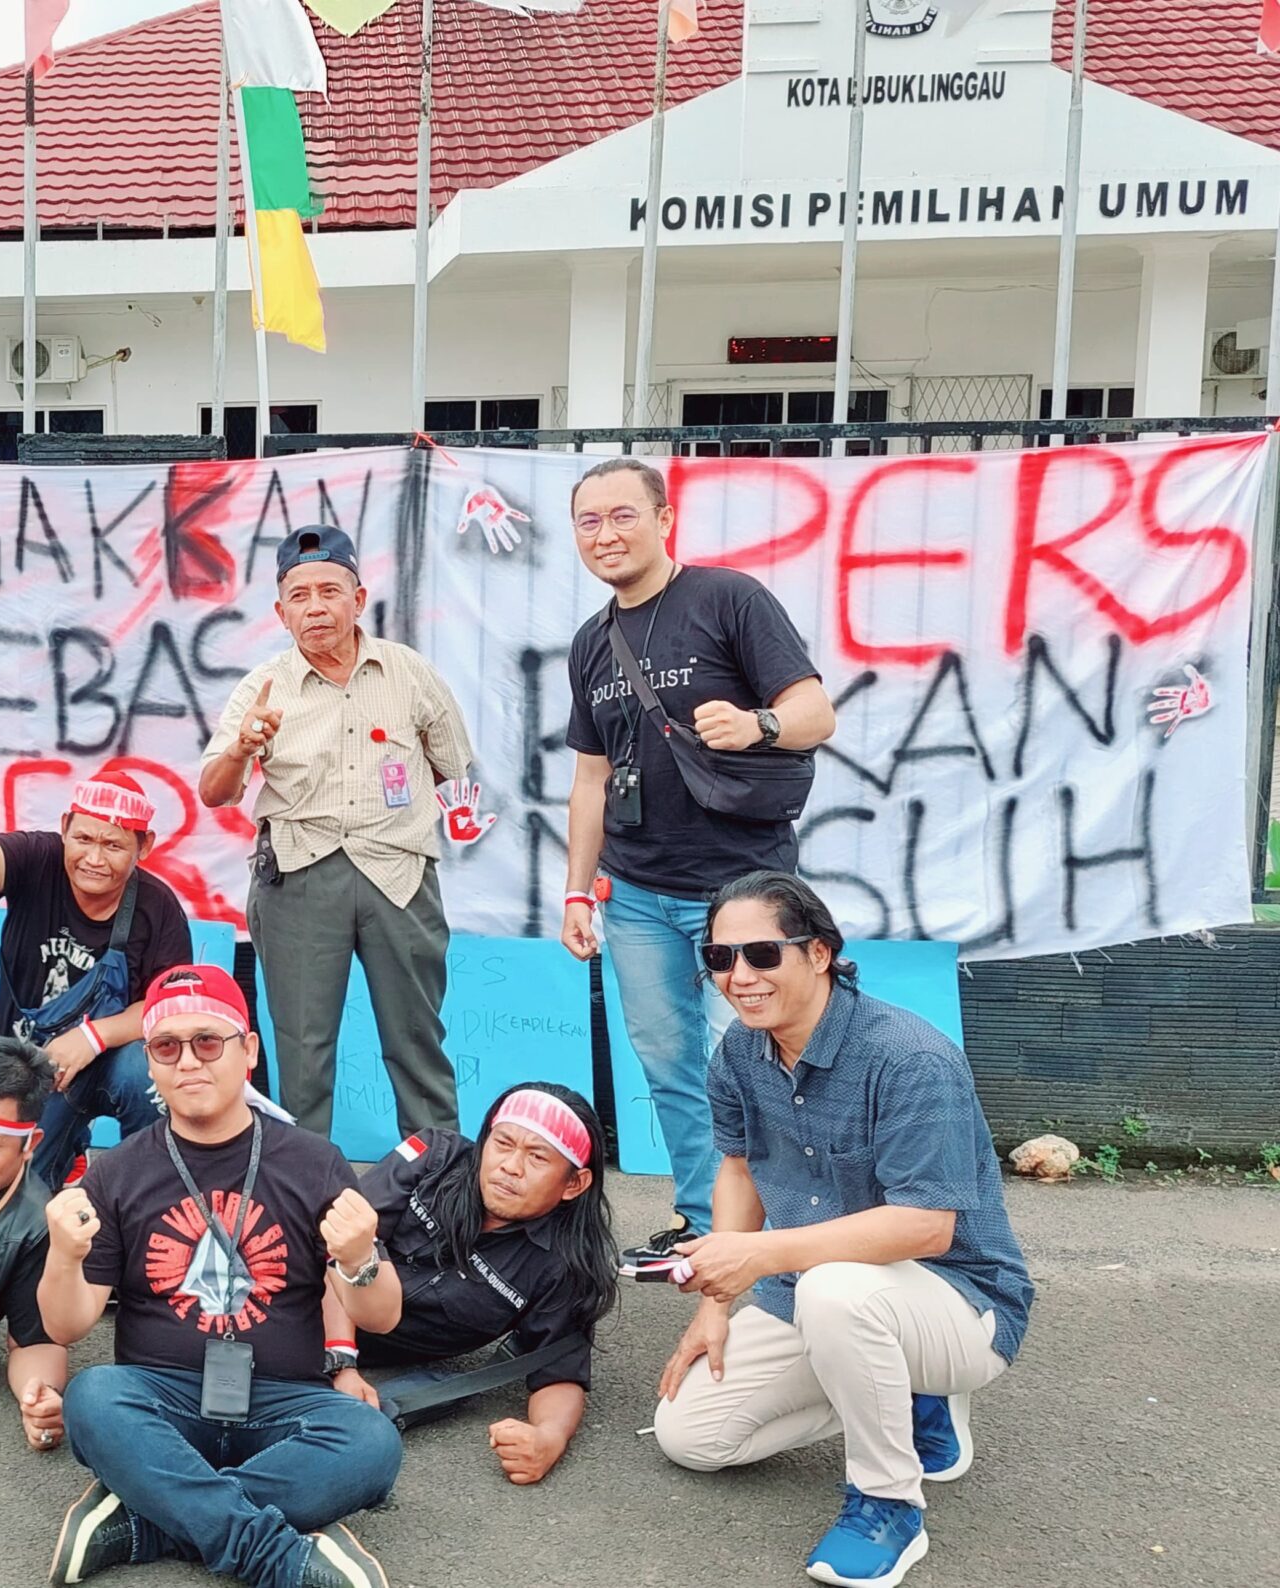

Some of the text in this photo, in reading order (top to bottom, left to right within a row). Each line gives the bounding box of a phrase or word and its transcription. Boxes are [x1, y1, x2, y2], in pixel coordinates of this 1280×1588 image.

[787, 78, 841, 107] KOTA
[629, 193, 791, 232] KOMISI
[1099, 179, 1249, 218] UMUM
[666, 434, 1265, 666] PERS
